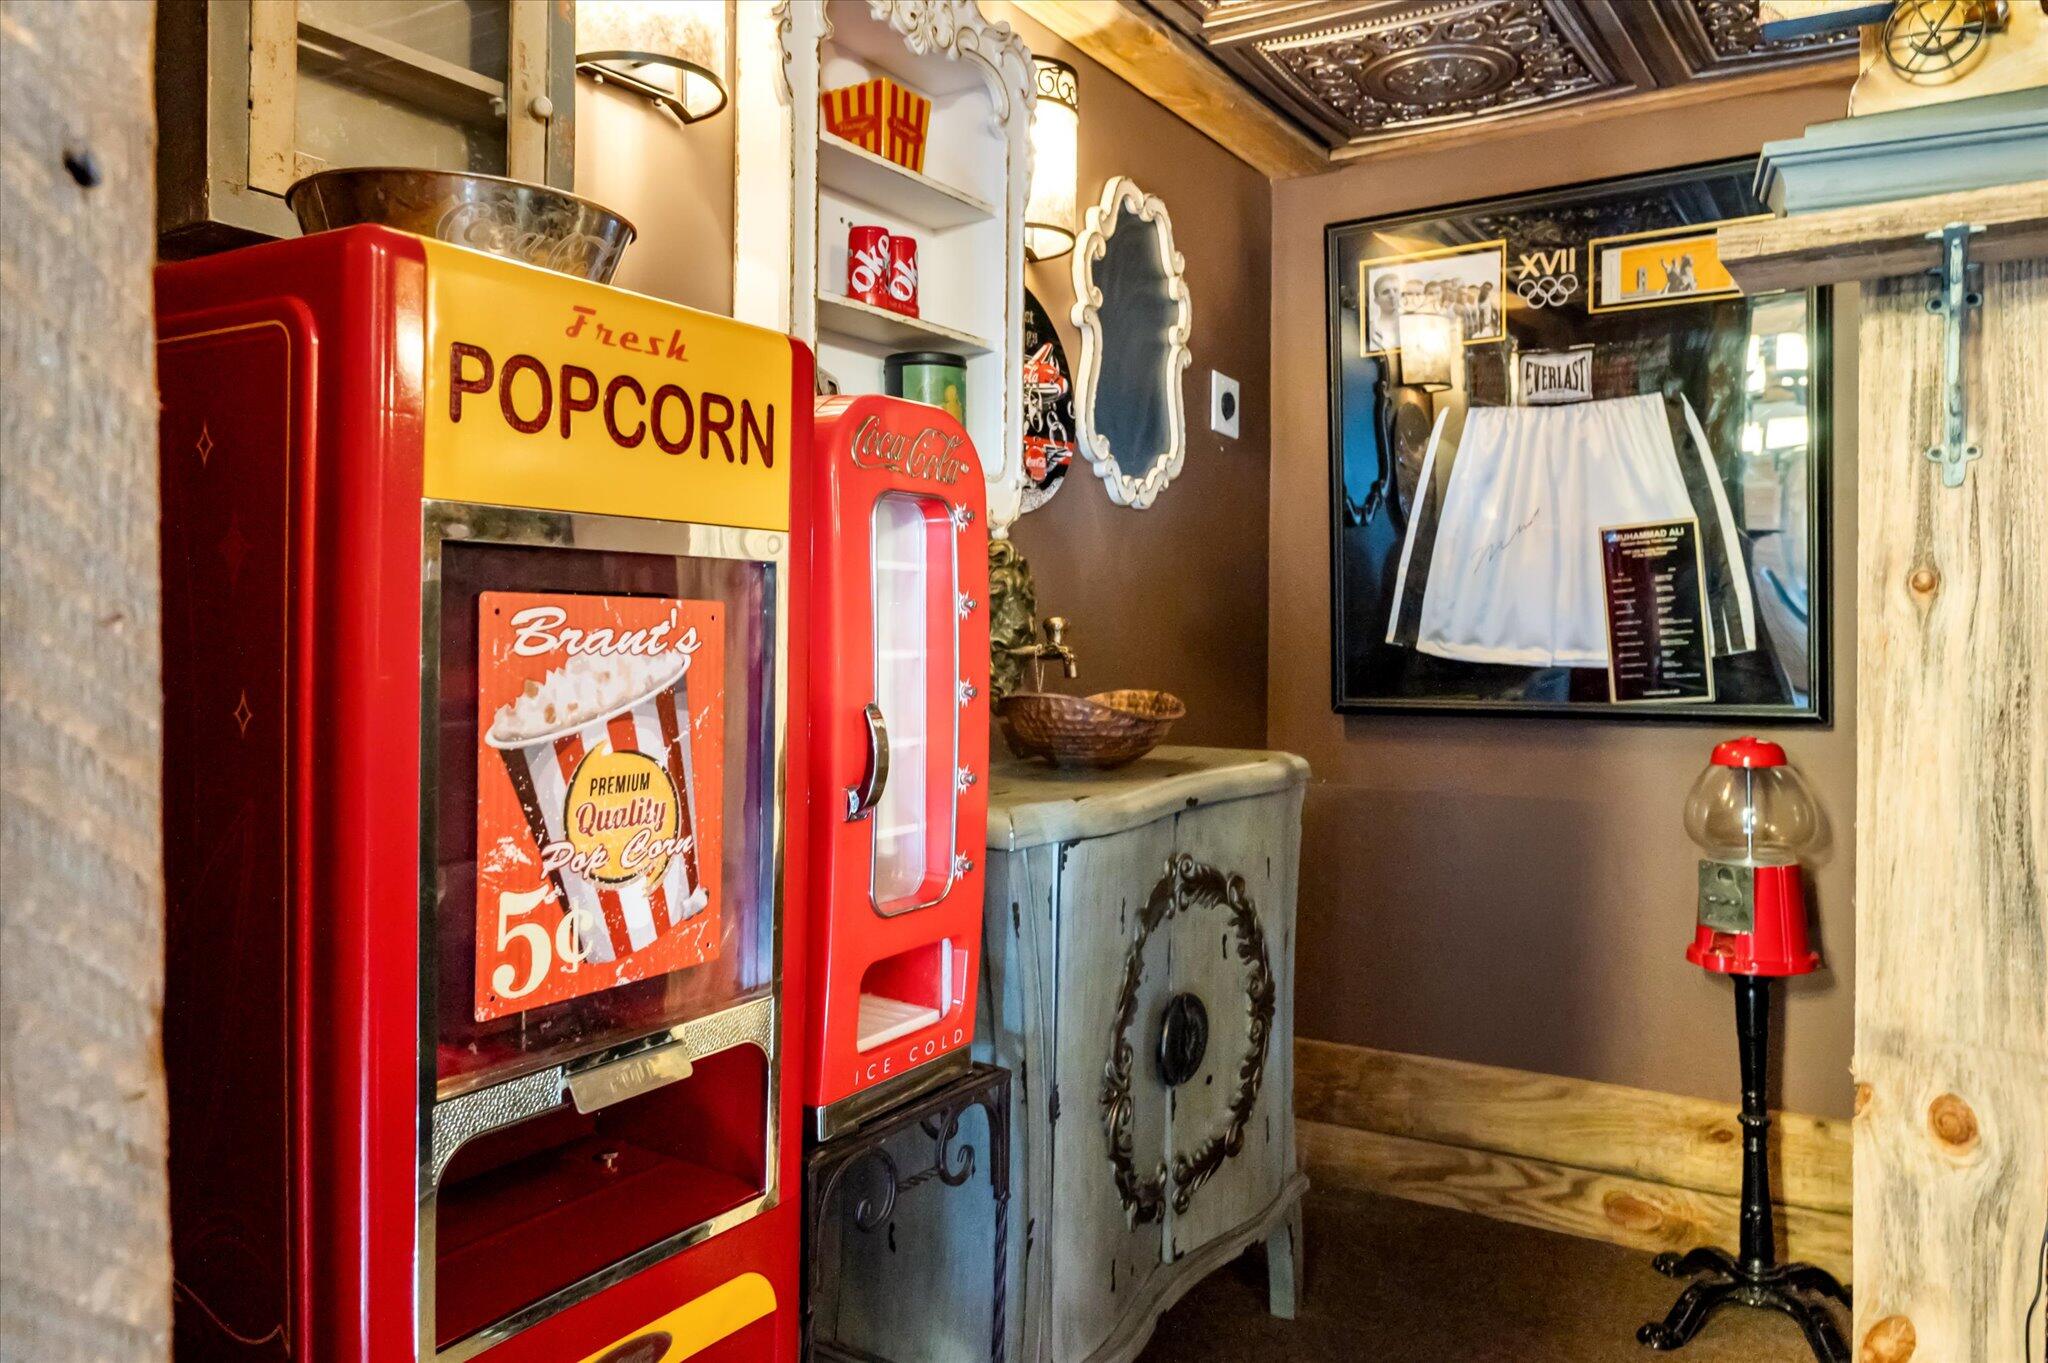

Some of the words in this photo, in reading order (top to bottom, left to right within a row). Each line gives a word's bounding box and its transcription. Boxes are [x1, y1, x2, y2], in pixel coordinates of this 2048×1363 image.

[851, 235, 890, 293] oke
[1518, 247, 1576, 280] XVII
[566, 305, 689, 362] Fresh
[1525, 356, 1586, 396] EVERLAST
[449, 341, 775, 469] POPCORN
[1669, 526, 1685, 538] ALI
[510, 606, 703, 657] Brant's
[589, 772, 651, 796] PREMIUM
[576, 797, 667, 837] Quality
[541, 840, 610, 880] Pop
[620, 828, 694, 871] Corn
[854, 1057, 892, 1086] ICE
[909, 1028, 964, 1062] COLD
